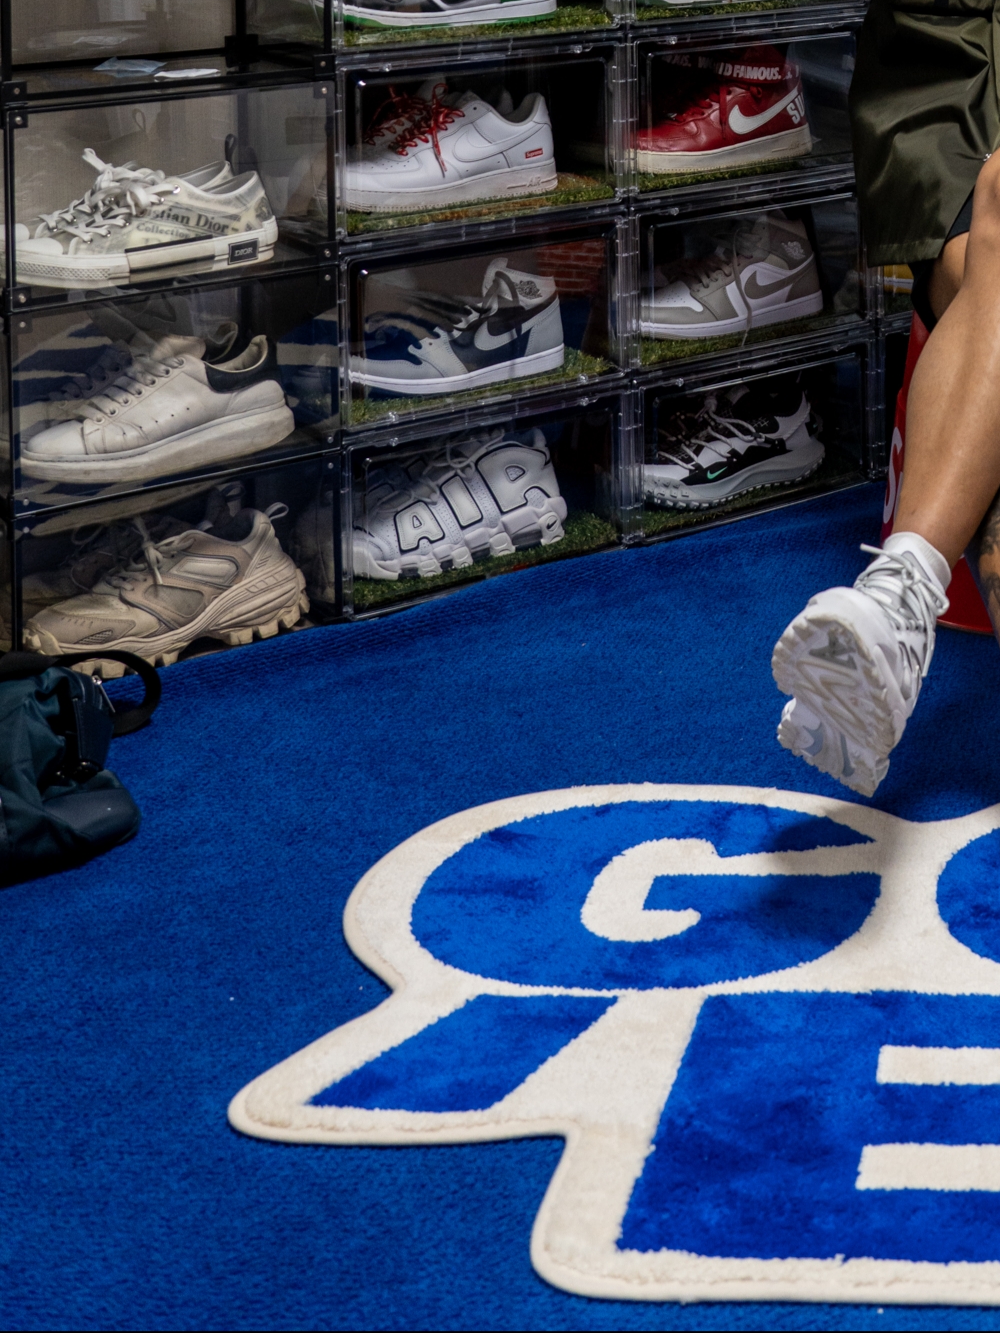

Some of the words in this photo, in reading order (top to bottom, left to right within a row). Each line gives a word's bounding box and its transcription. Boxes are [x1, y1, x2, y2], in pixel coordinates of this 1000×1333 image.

[733, 63, 782, 81] FAMOUS.
[195, 214, 229, 233] Dior
[234, 247, 253, 257] DIOR
[394, 443, 553, 553] AIR
